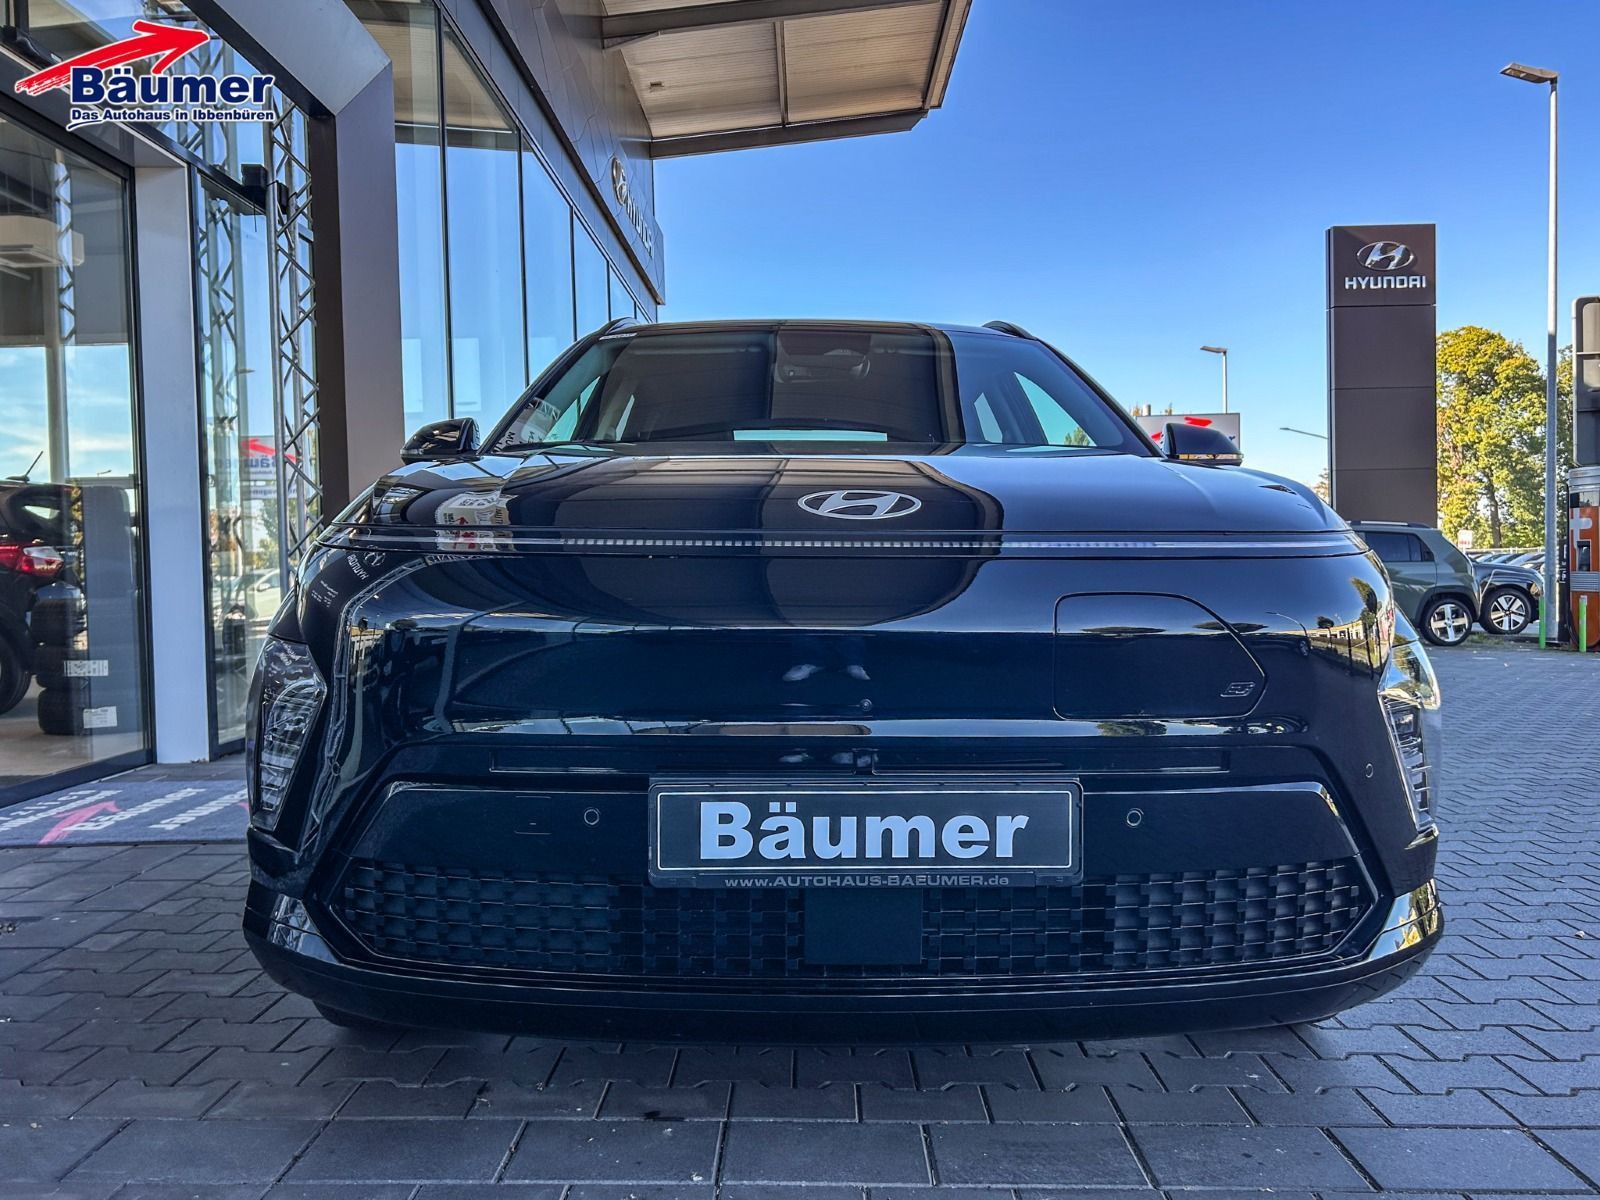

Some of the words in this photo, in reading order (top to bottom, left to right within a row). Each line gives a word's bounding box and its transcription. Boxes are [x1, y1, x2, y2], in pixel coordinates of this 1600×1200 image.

[1344, 275, 1427, 290] HYUNDAI
[699, 800, 1030, 861] Bäumer
[724, 874, 1010, 888] www.AUTOHAUS-BAEUMER.de
